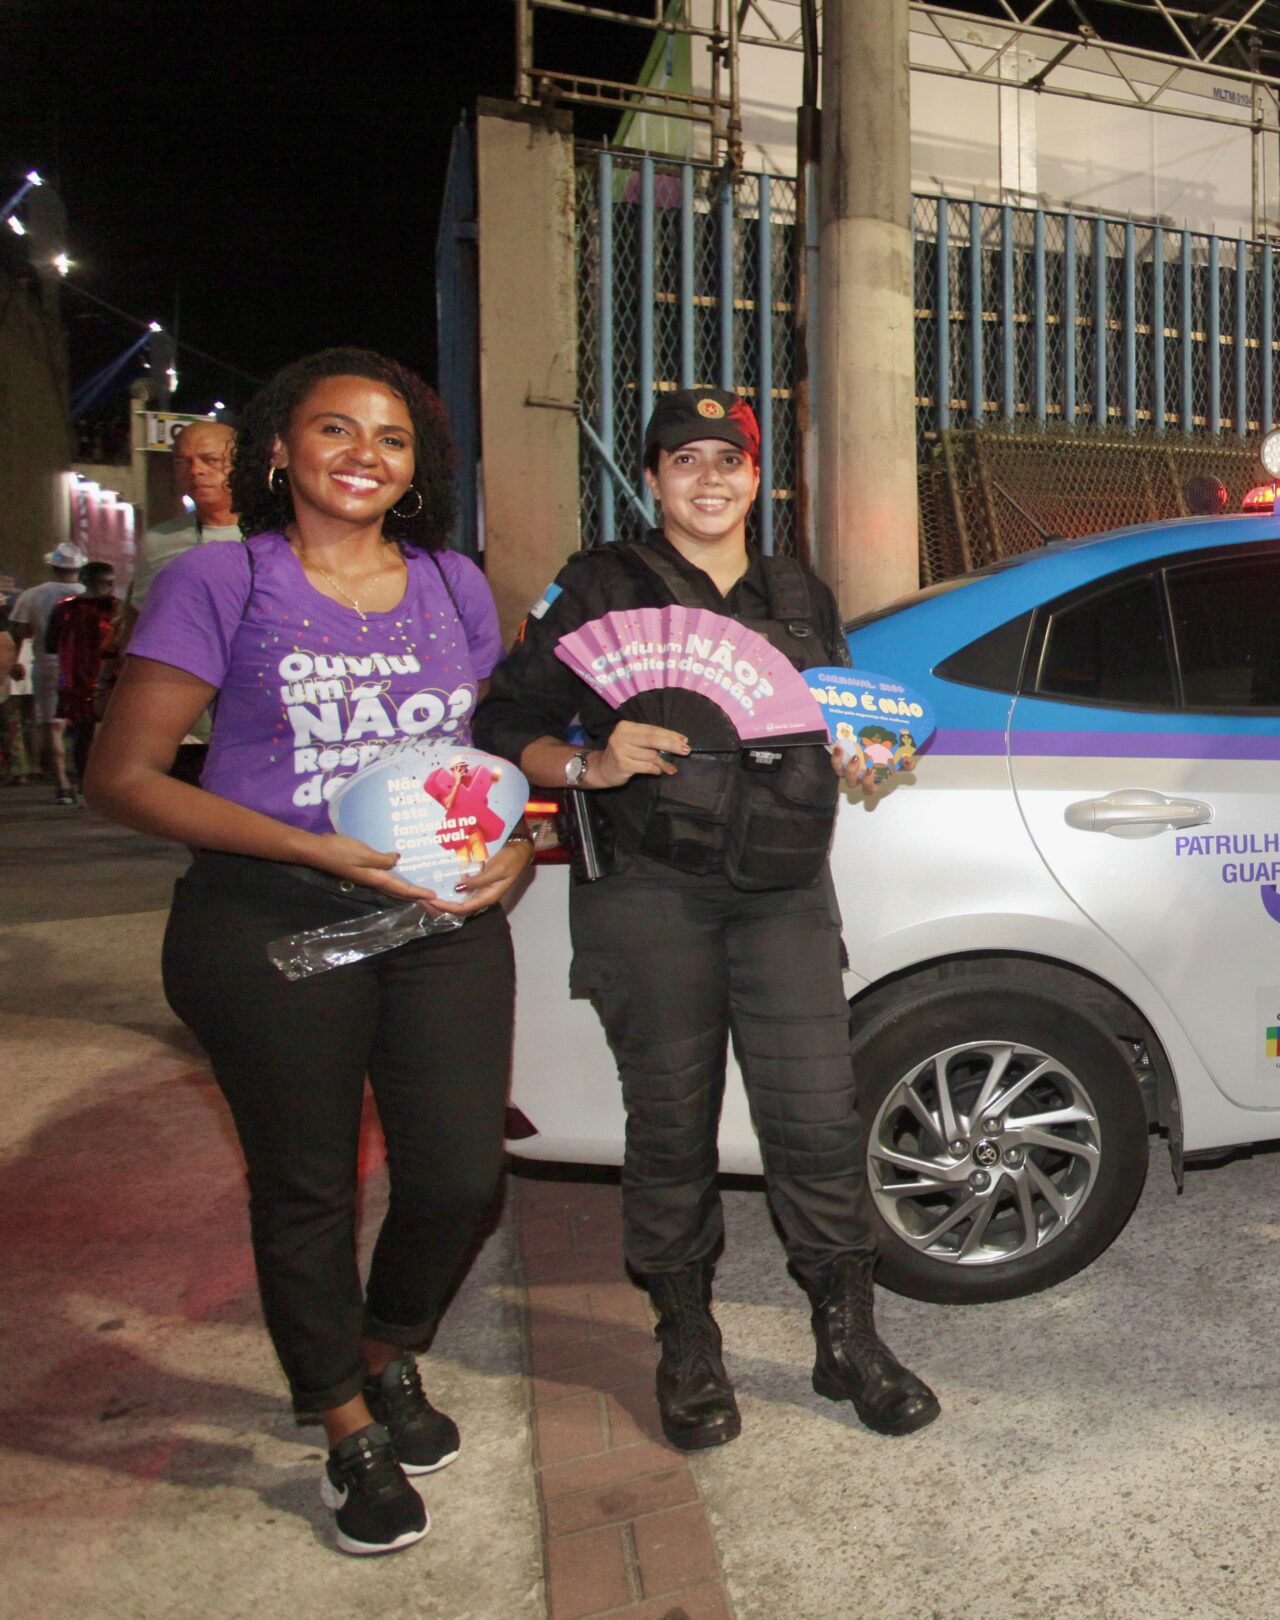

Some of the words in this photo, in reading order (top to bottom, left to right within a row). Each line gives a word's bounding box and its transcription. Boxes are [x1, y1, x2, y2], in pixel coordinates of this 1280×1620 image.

[278, 653, 421, 681] Ouviu
[591, 641, 654, 672] Ouviu
[657, 641, 682, 654] um
[686, 634, 774, 699] NÃO?
[280, 680, 345, 705] um
[595, 658, 665, 687] Respeite
[678, 656, 755, 717] decisão.
[809, 685, 857, 708] NÃO
[860, 691, 877, 711] É
[878, 697, 923, 718] NÃO
[288, 685, 473, 747] NÃO?
[387, 776, 421, 793] Não
[391, 807, 429, 822] esta
[392, 815, 457, 837] fantasia
[458, 815, 478, 827] no
[395, 828, 470, 850] Carnaval.
